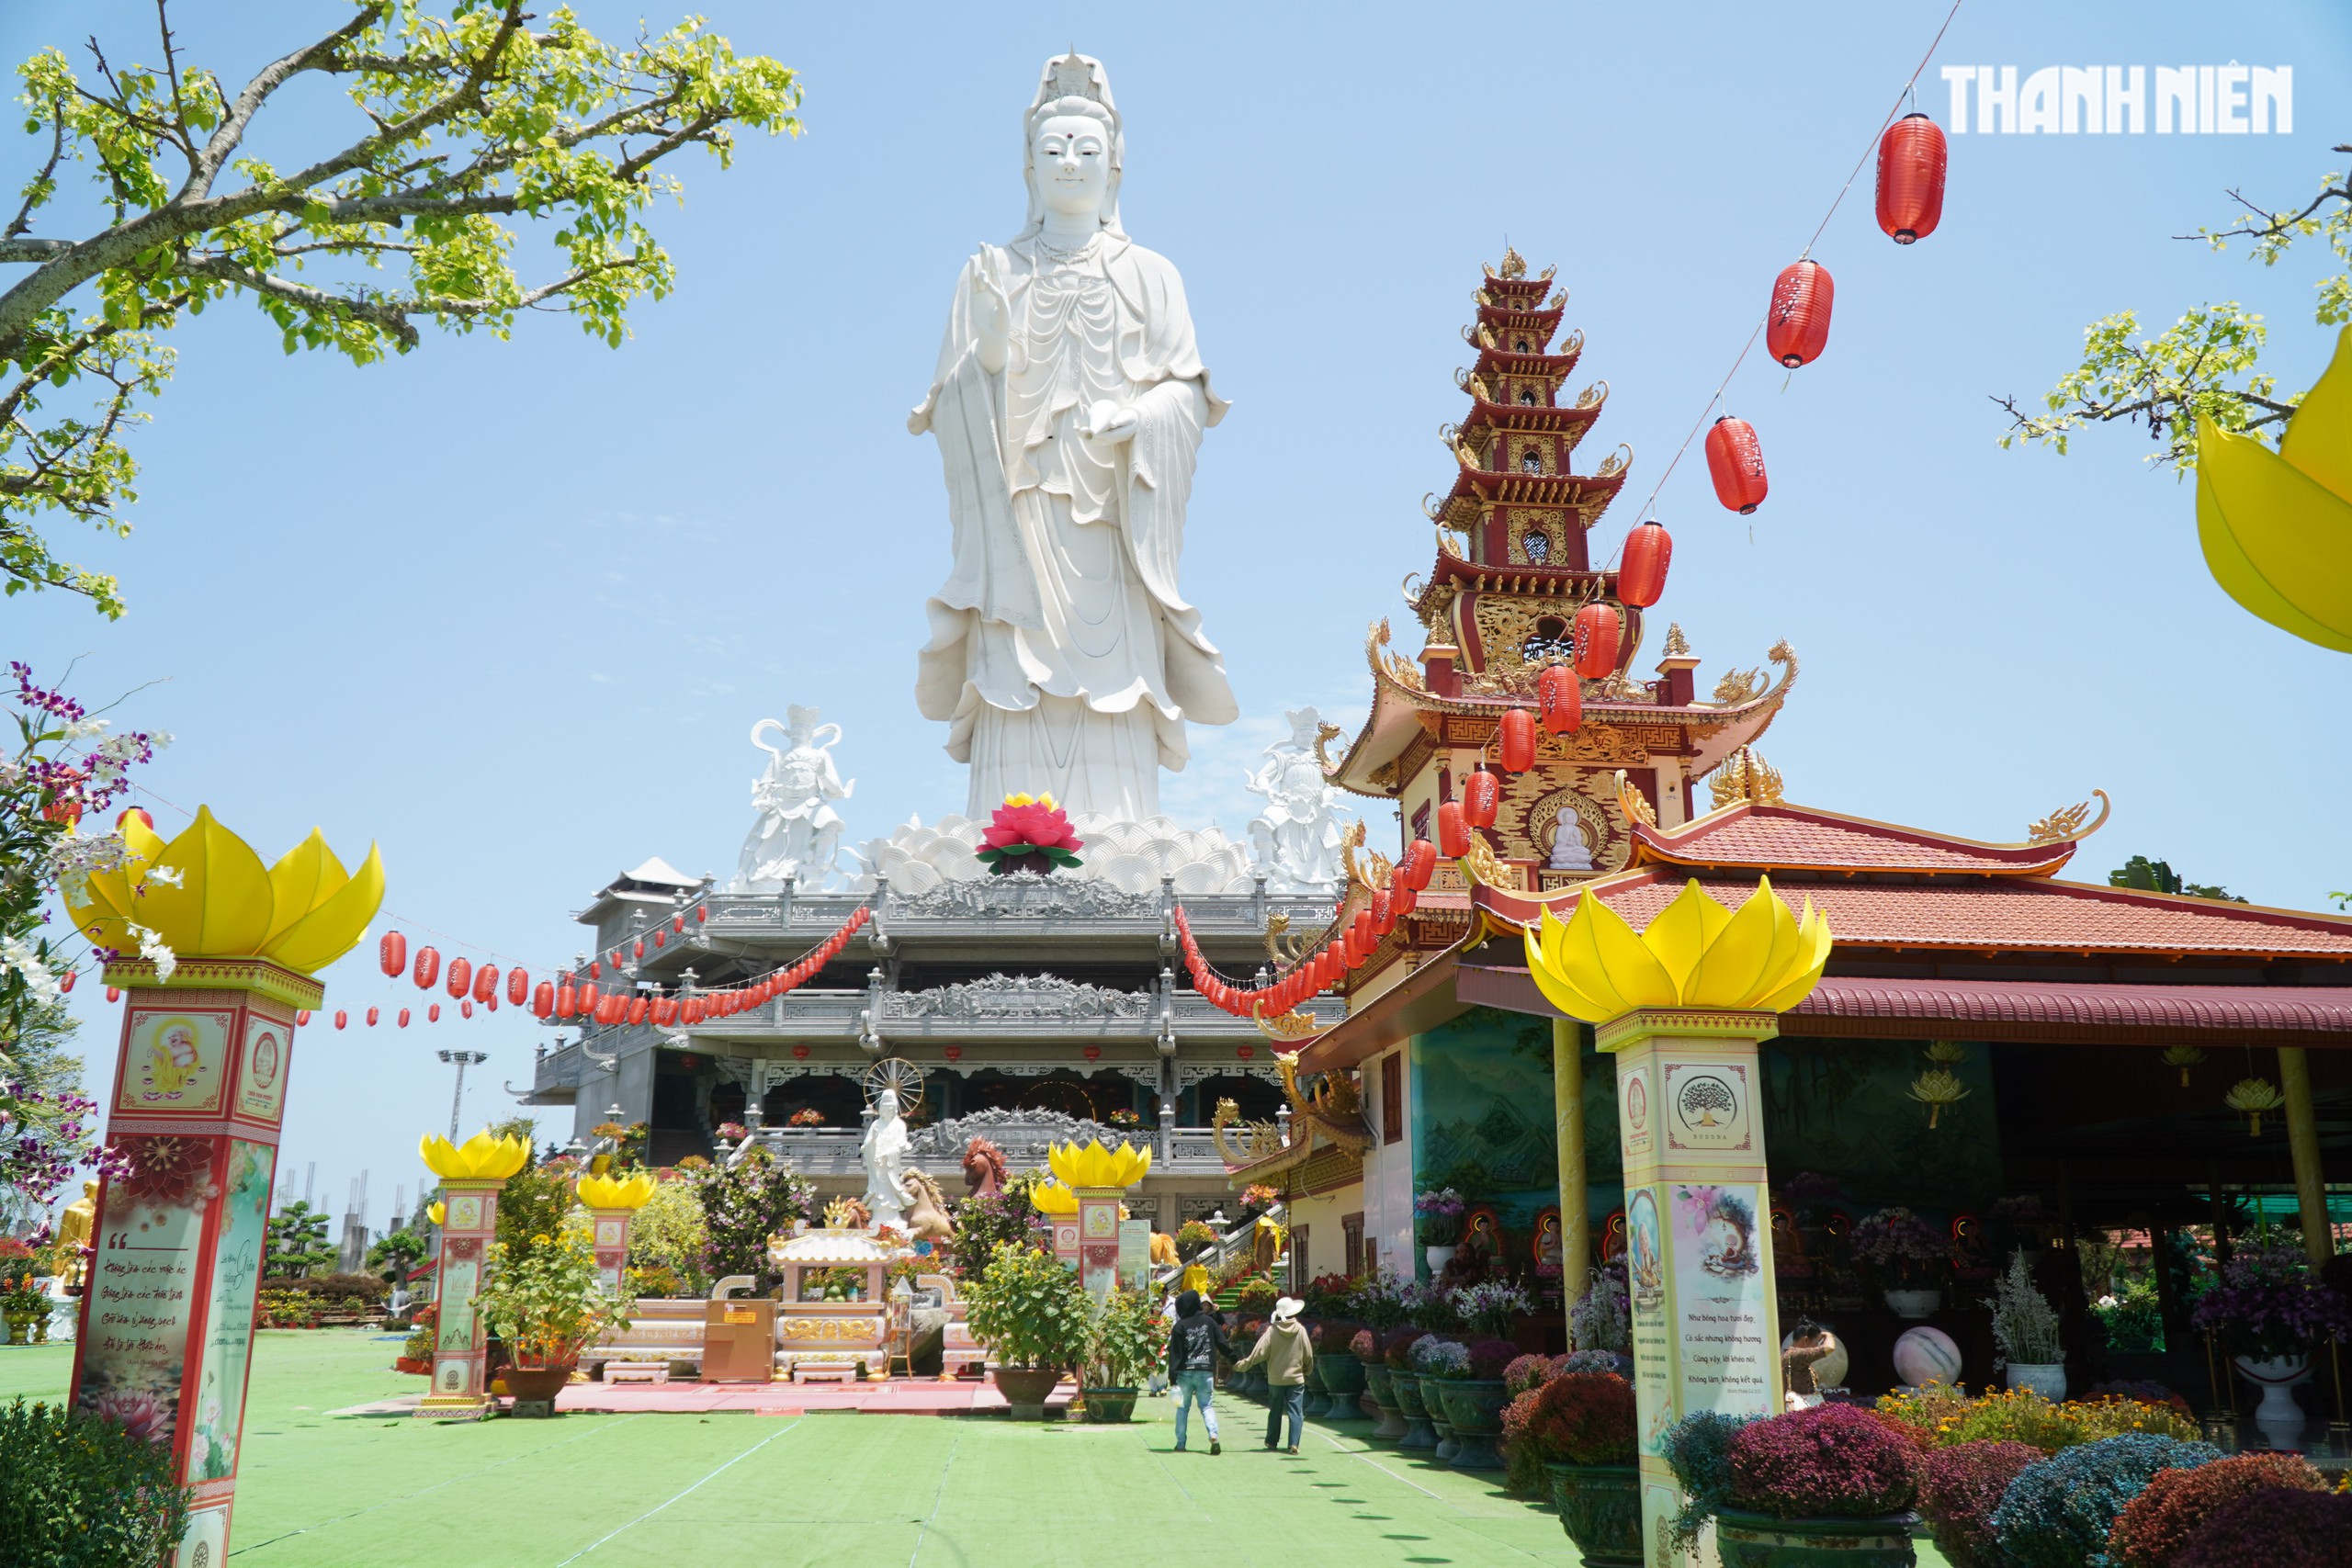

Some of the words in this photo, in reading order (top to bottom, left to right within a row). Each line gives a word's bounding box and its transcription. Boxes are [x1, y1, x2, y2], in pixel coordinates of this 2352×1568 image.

[1688, 1314, 1702, 1322] Như
[1702, 1314, 1716, 1324] bông
[1717, 1314, 1729, 1322] hoa
[1685, 1334, 1693, 1342] Có
[1694, 1334, 1704, 1342] sắc
[1705, 1335, 1724, 1344] nhưng
[1724, 1335, 1742, 1344] không
[1743, 1336, 1761, 1344] hương
[1688, 1375, 1707, 1385] Không
[1721, 1375, 1739, 1385] không
[1740, 1374, 1751, 1383] kết
